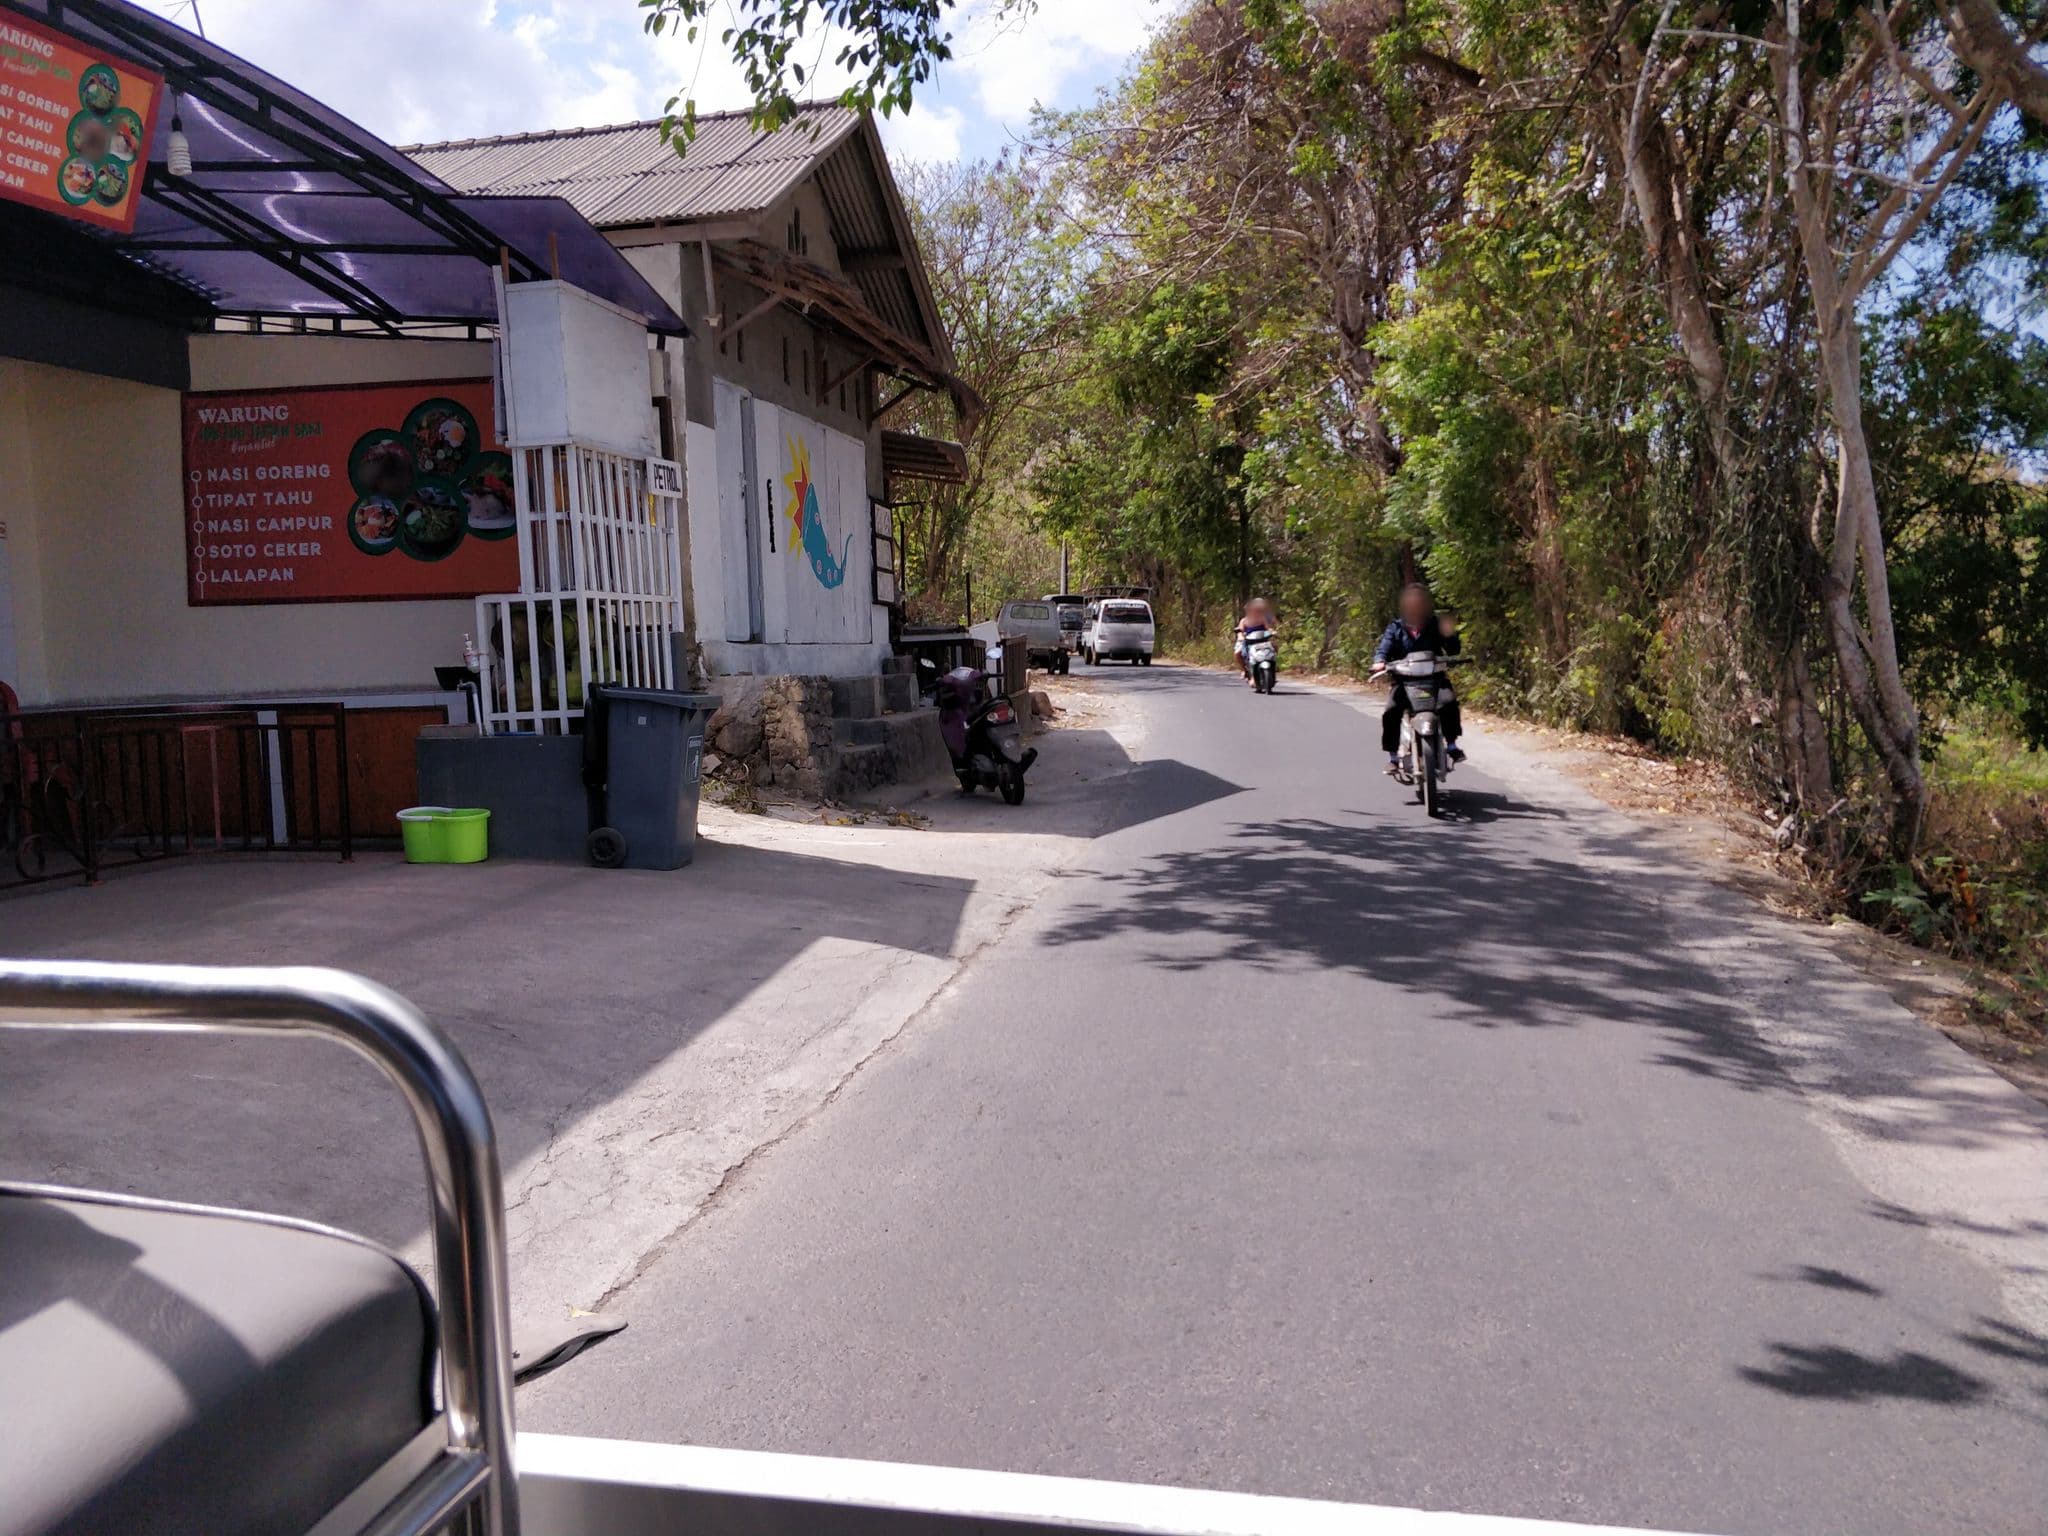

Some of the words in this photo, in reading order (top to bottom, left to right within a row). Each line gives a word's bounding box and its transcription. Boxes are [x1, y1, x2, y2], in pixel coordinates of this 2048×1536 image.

[0, 25, 54, 58] ARUNG
[17, 90, 70, 119] GORENG
[18, 112, 54, 134] TAHU
[7, 130, 62, 159] CAMPUR
[6, 152, 49, 176] CEKER
[198, 405, 289, 424] WARUNG
[207, 465, 249, 482] NASI
[256, 464, 331, 480] GORENG
[654, 463, 681, 493] PETROL
[206, 493, 257, 508] TIPAT
[263, 491, 313, 505] TAHU
[208, 518, 249, 533] NASI
[256, 516, 333, 532] CAMPUR
[209, 544, 257, 559] SOTO
[263, 542, 322, 557] CEKER
[210, 568, 294, 583] LALAPAN
